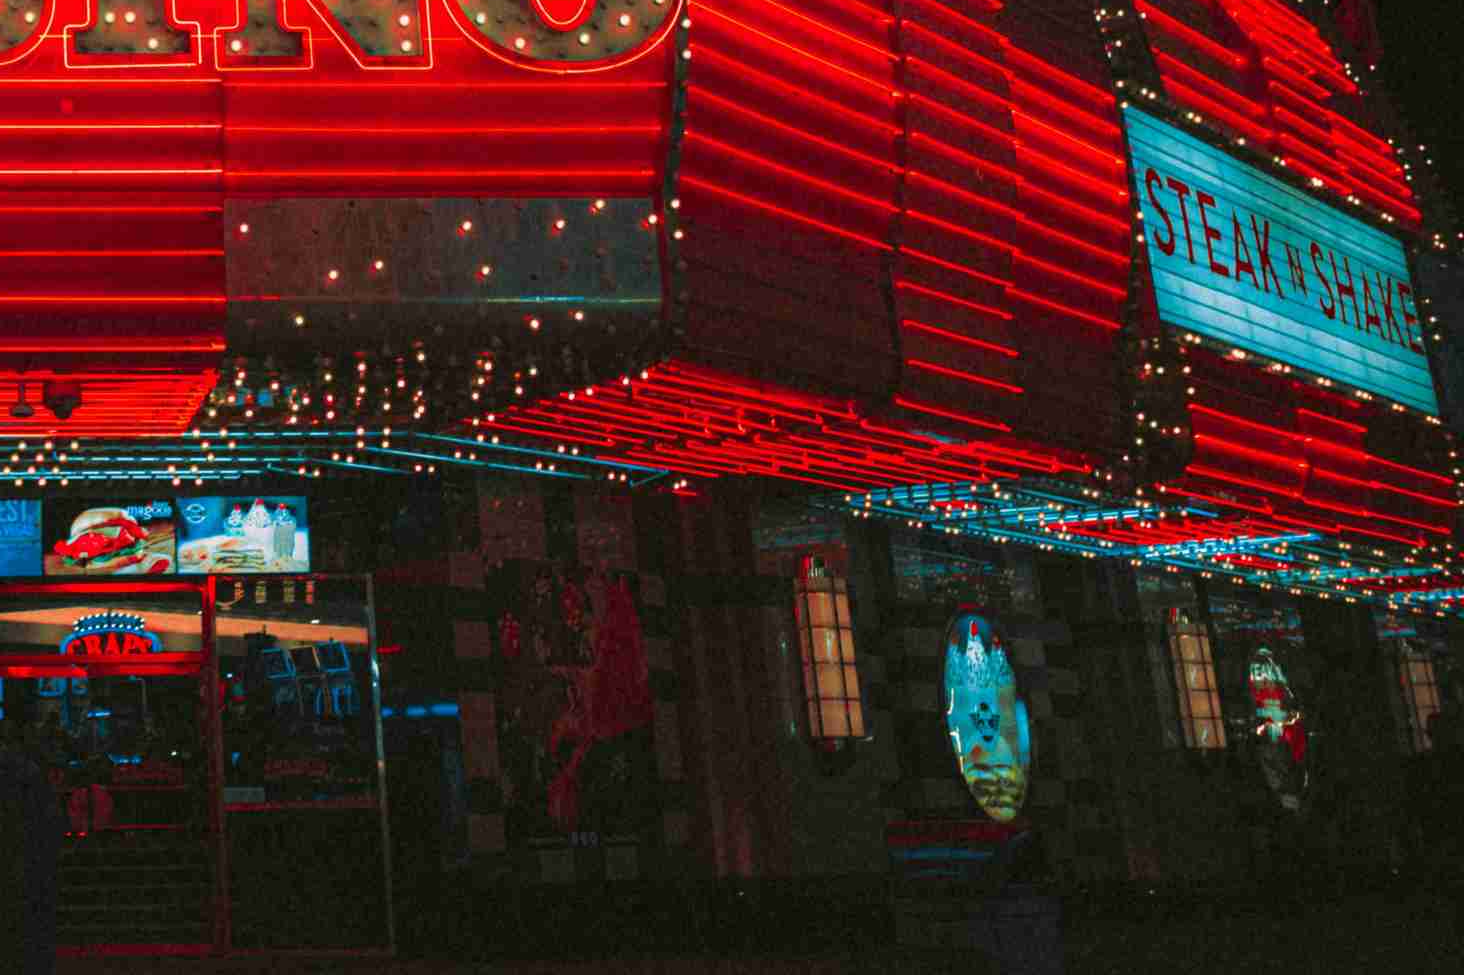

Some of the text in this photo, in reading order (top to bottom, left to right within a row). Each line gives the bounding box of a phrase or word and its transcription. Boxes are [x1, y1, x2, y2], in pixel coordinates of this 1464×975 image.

[1145, 167, 1425, 356] STEAK N SHAKE
